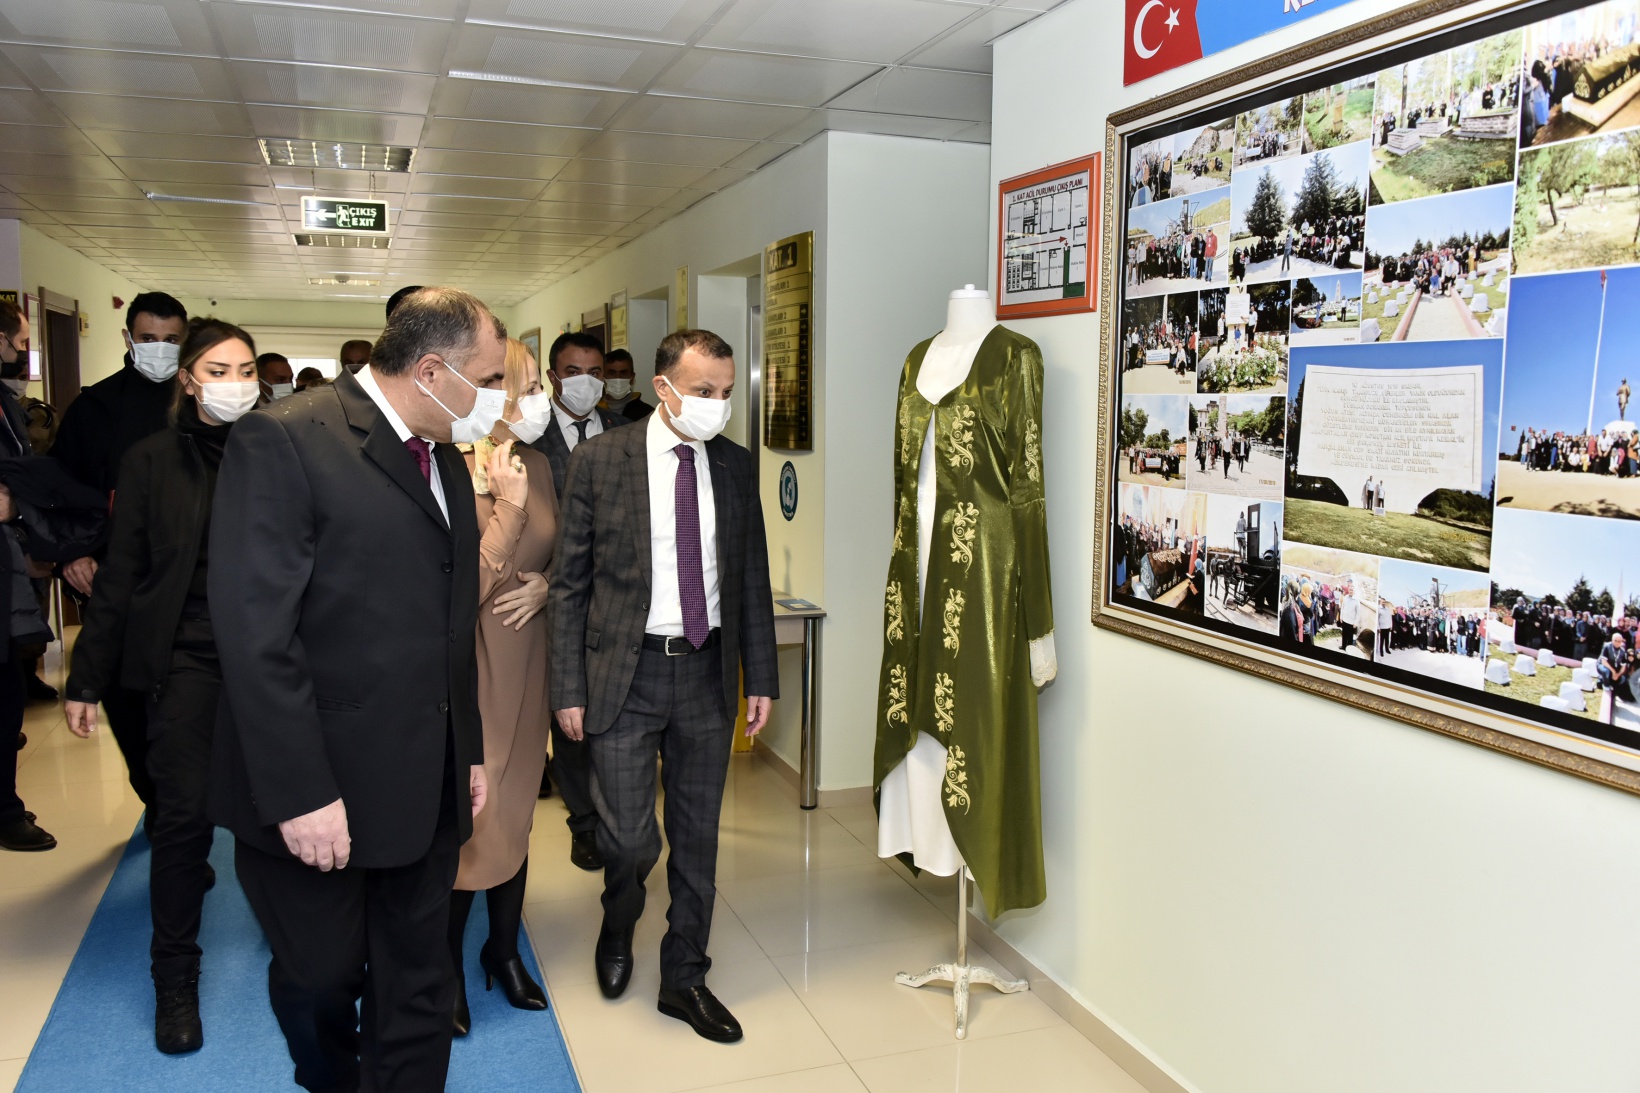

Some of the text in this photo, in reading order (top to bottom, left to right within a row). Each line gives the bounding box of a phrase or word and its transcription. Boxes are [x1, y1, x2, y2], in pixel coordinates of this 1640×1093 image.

[1017, 193, 1026, 201] KAT
[1026, 188, 1036, 199] ACİL
[1036, 185, 1056, 197] DURUMU
[1057, 182, 1069, 193] ÇIKIŞ
[1069, 178, 1084, 189] PLANI
[349, 207, 377, 218] ÇIKIŞ
[351, 217, 375, 227] EXIT
[787, 245, 794, 266] 1
